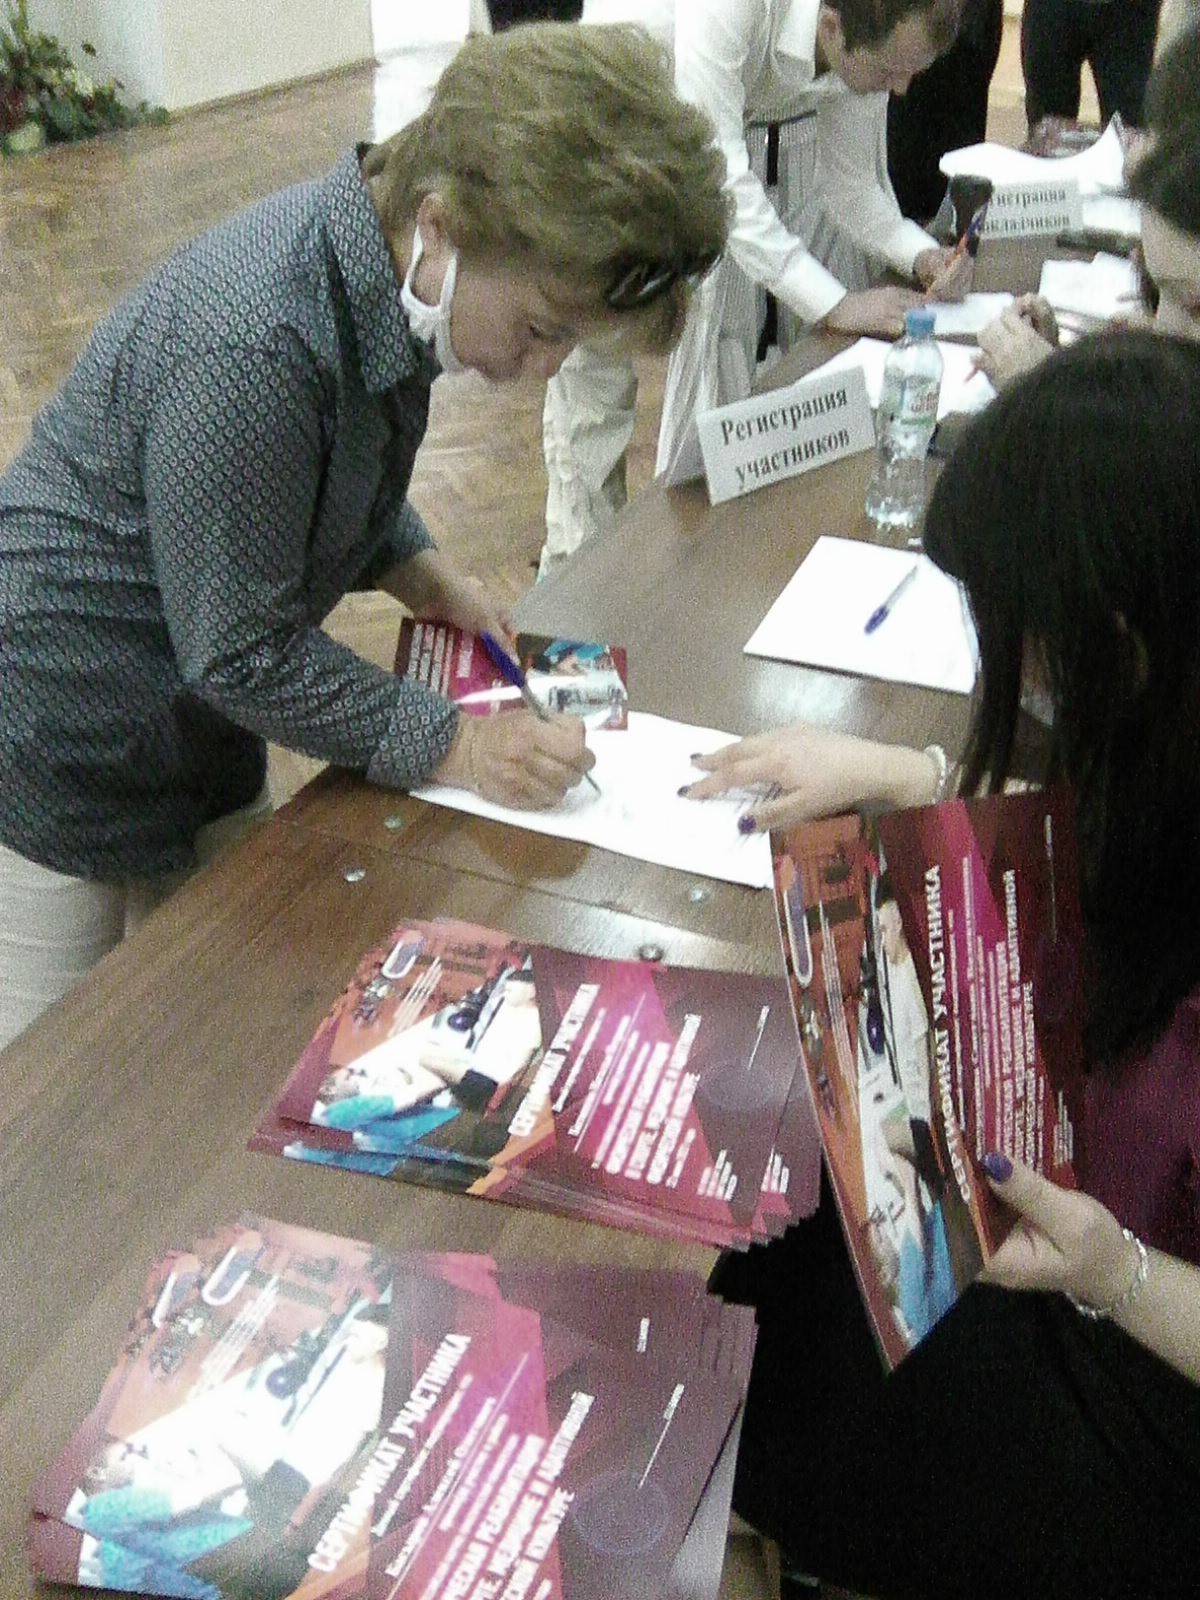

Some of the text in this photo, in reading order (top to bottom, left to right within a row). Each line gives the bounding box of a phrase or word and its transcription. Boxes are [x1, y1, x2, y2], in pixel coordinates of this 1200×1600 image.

[720, 388, 848, 446] Регистрация
[735, 428, 850, 491] участников
[1003, 868, 1020, 983] АДАПТИВНОЙ
[924, 864, 971, 1202] СЕРТИФИКАТ УЧАСТНИКА
[307, 1436, 406, 1572] СЕРТИФИКАТ
[388, 1333, 471, 1439] УЧАСТНИКА
